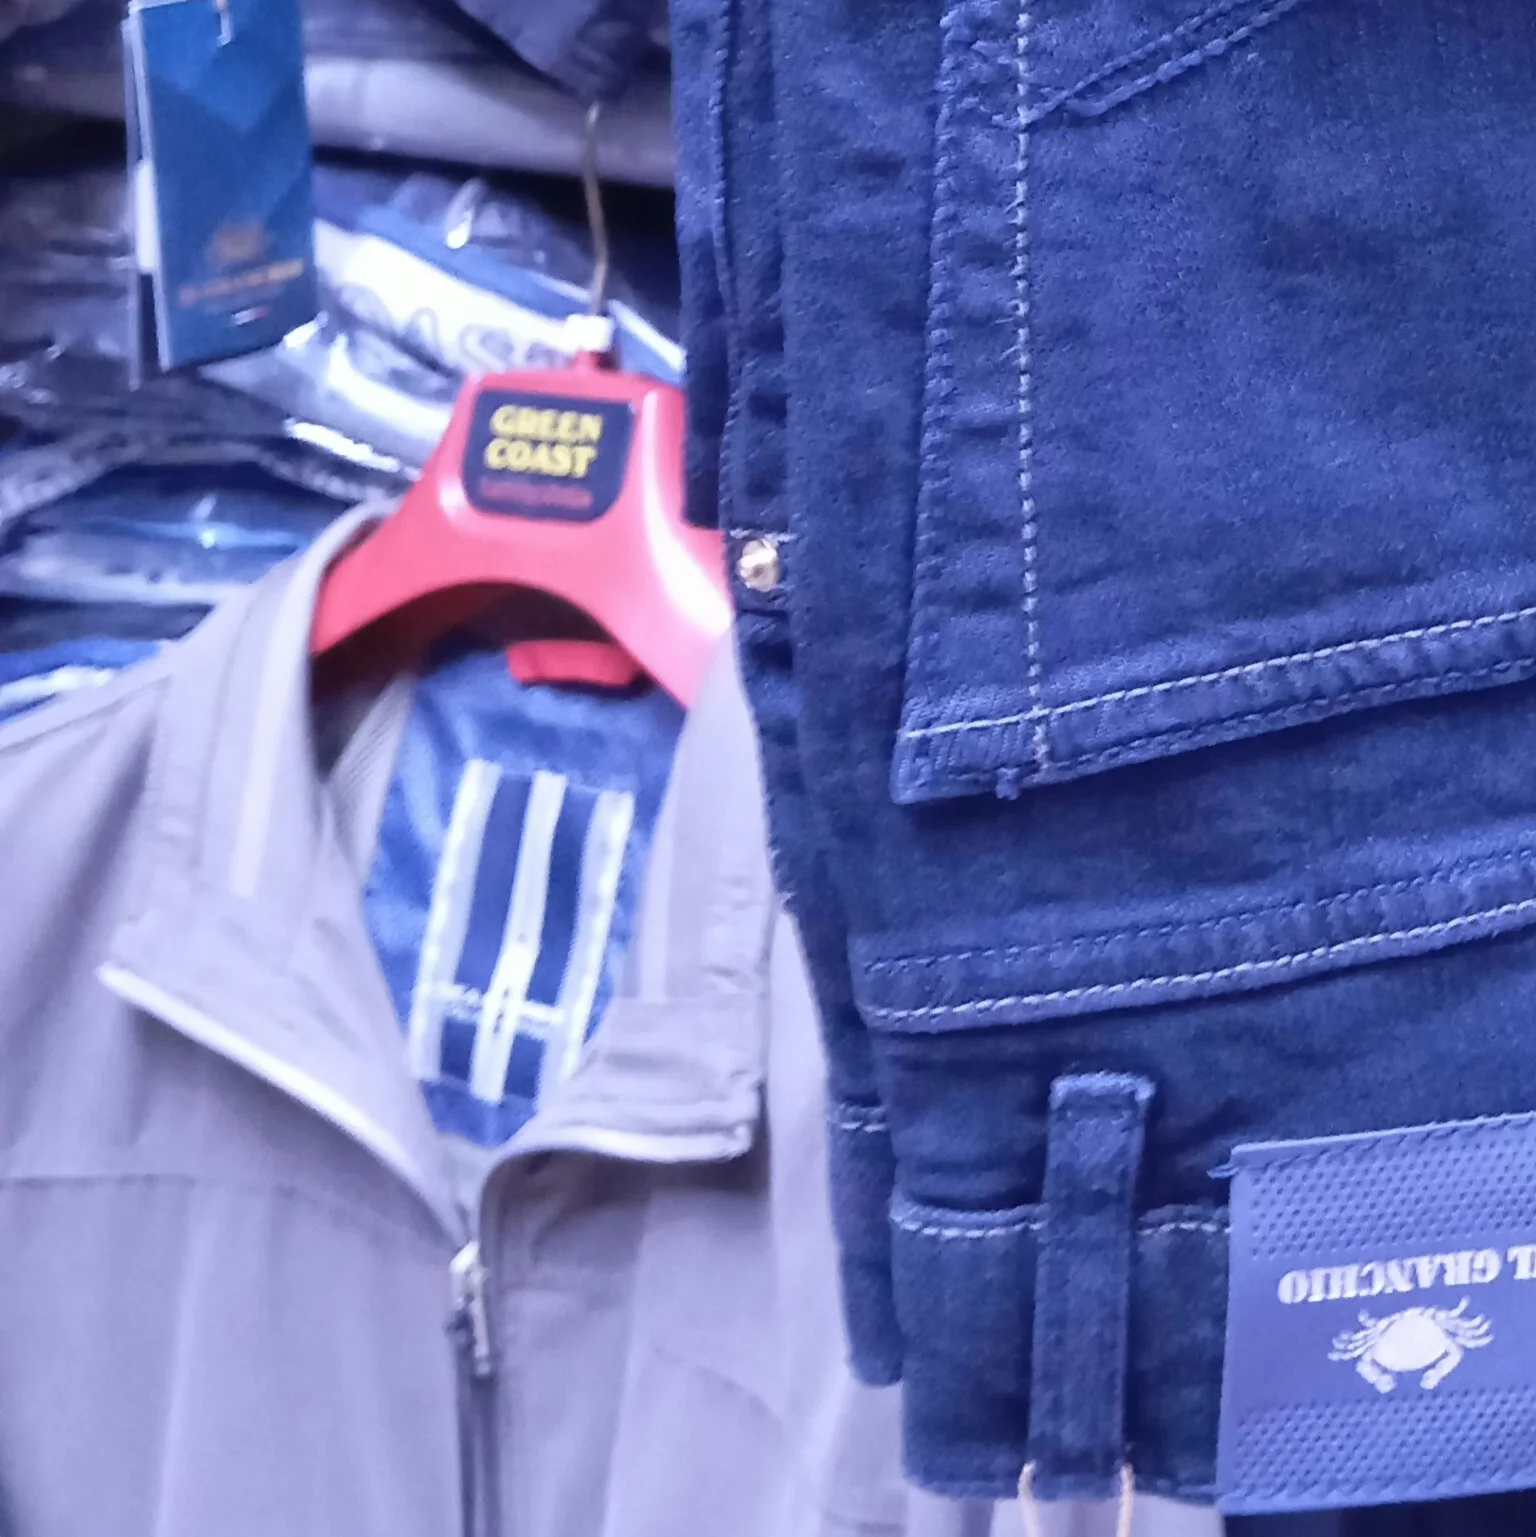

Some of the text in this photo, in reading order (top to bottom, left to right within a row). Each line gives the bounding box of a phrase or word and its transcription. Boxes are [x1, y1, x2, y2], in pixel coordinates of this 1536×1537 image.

[489, 404, 604, 443] GREEN
[484, 438, 598, 478] COAST
[1277, 1247, 1502, 1304] GRANCHIO
